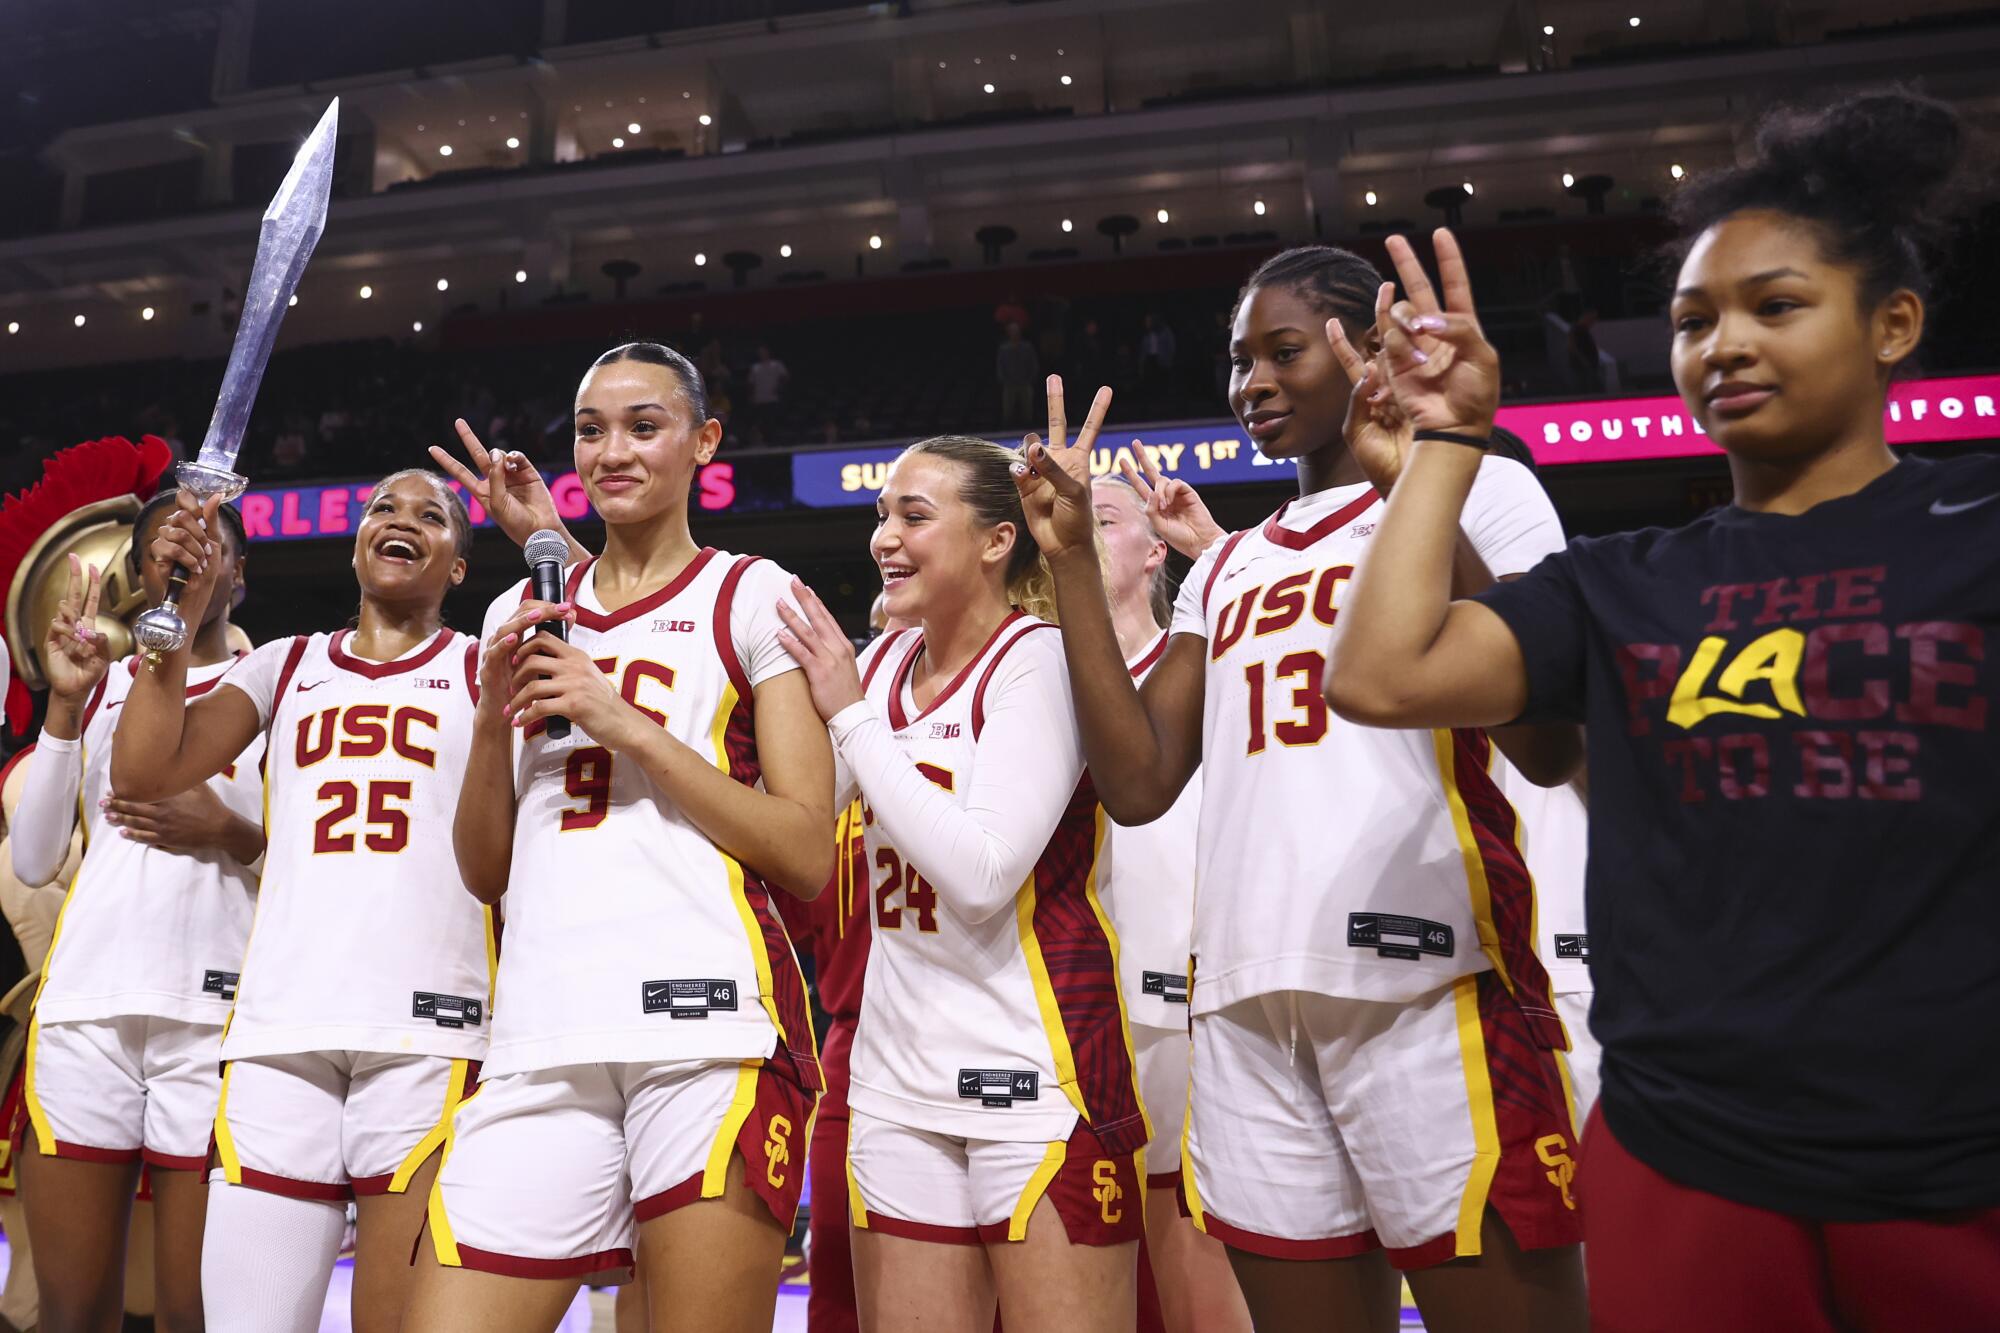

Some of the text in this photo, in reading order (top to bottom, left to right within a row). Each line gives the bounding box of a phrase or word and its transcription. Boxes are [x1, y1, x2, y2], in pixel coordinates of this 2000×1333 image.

[841, 462, 896, 491] SU
[1194, 440, 1240, 469] 1ST
[1700, 564, 1887, 632] THE
[1244, 648, 1329, 758] 13
[1614, 618, 1990, 738] PLACE
[295, 704, 440, 770] USC
[1663, 730, 1922, 806] TO BE
[312, 780, 413, 856] 25
[559, 745, 615, 833] 9
[874, 845, 940, 934] 24
[1427, 931, 1446, 945] 46
[466, 1005, 478, 1017] 46
[713, 988, 730, 1001] 46
[1016, 1078, 1031, 1091] 44
